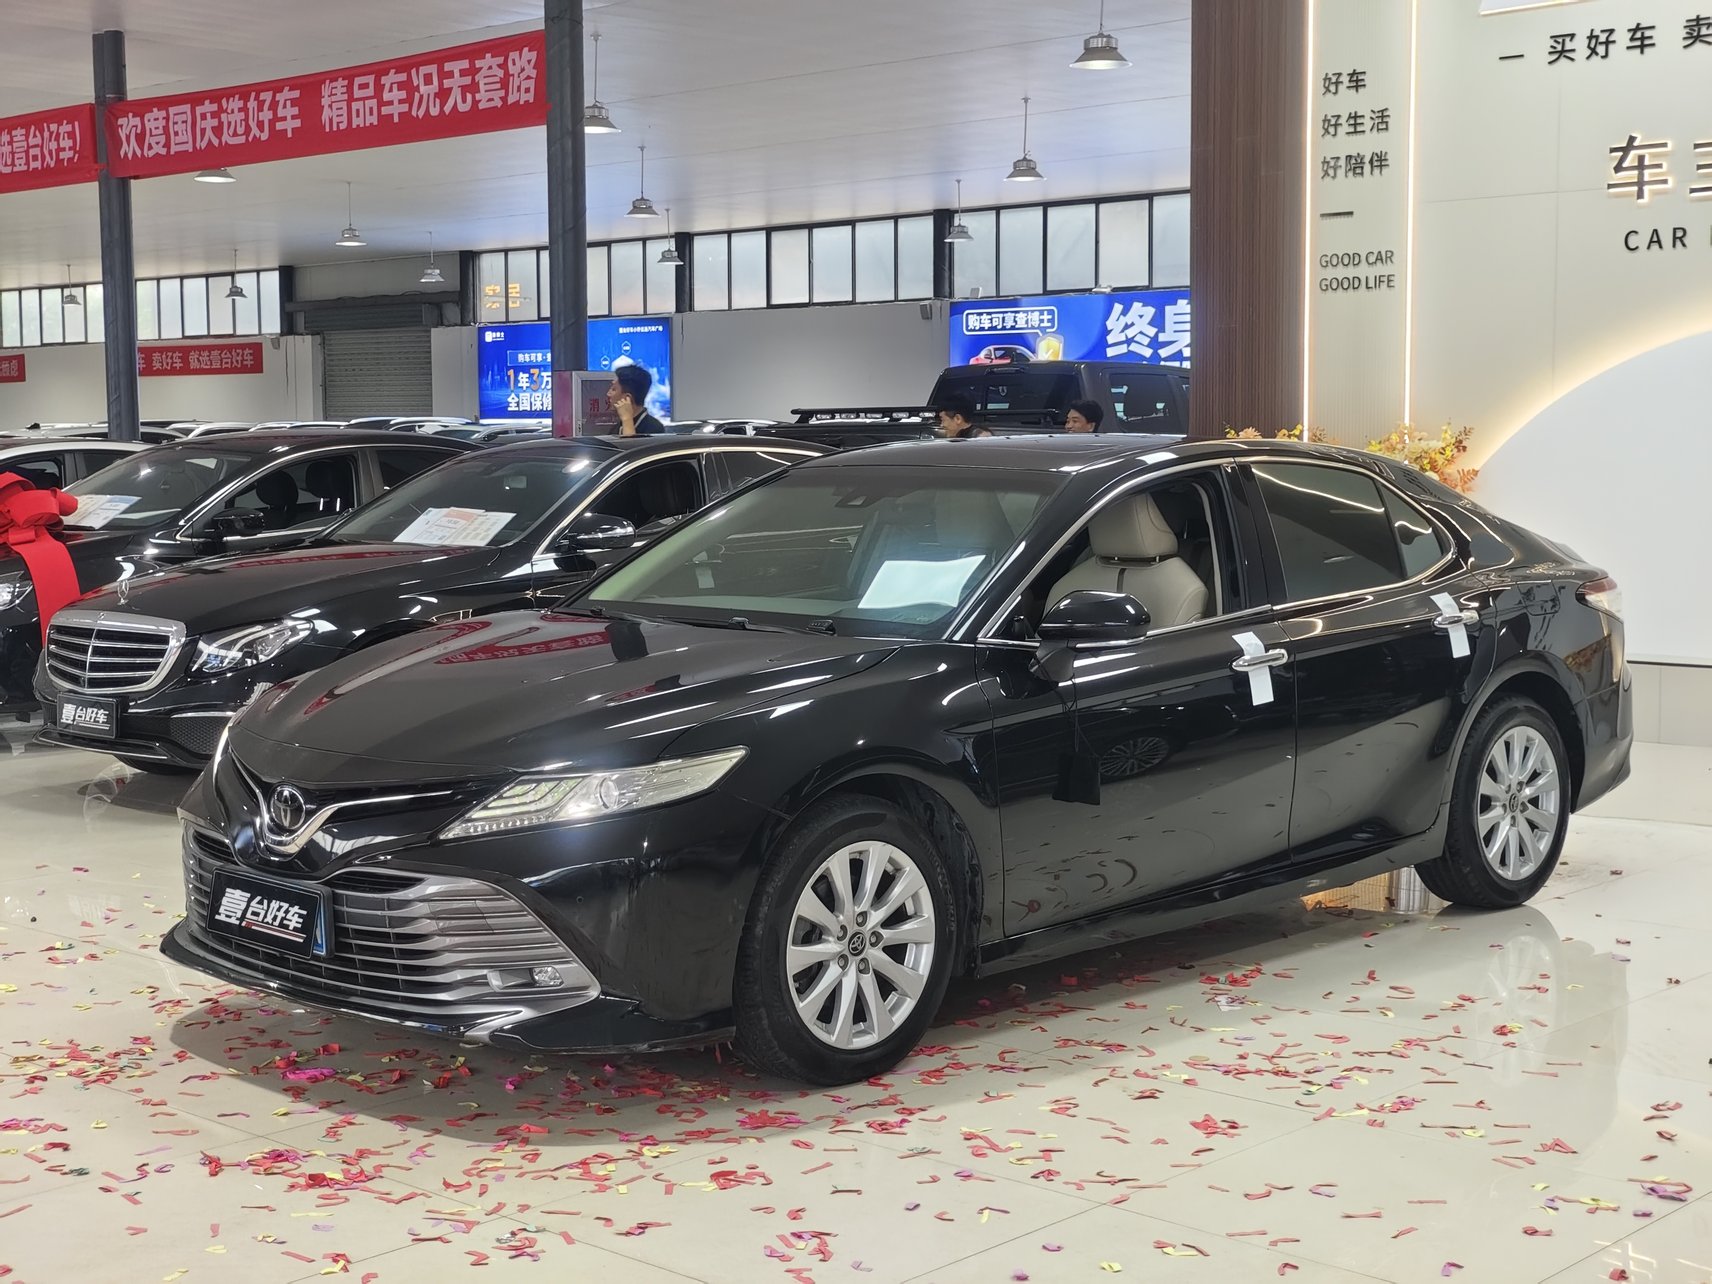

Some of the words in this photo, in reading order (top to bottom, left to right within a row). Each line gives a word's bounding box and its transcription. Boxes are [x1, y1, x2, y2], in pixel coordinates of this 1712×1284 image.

[1548, 23, 1656, 64] 买好车
[1322, 69, 1367, 95] 好车
[117, 86, 300, 161] 欢度国庆选好车
[321, 47, 538, 132] 精品车况无套路
[1321, 107, 1391, 137] 好生活
[1321, 150, 1390, 180] 好陪伴
[1624, 227, 1688, 251] CAR
[1319, 252, 1361, 268] GOOD
[1366, 250, 1395, 265] CAR
[1319, 276, 1361, 292] GOOD
[1365, 274, 1396, 289] LIFE
[967, 311, 1053, 330] 购车可享查博士
[152, 350, 184, 370] 卖好车
[188, 348, 255, 370] 就选壹台好车
[60, 703, 109, 724] 壹台好车
[214, 887, 308, 931] 壹台好车
